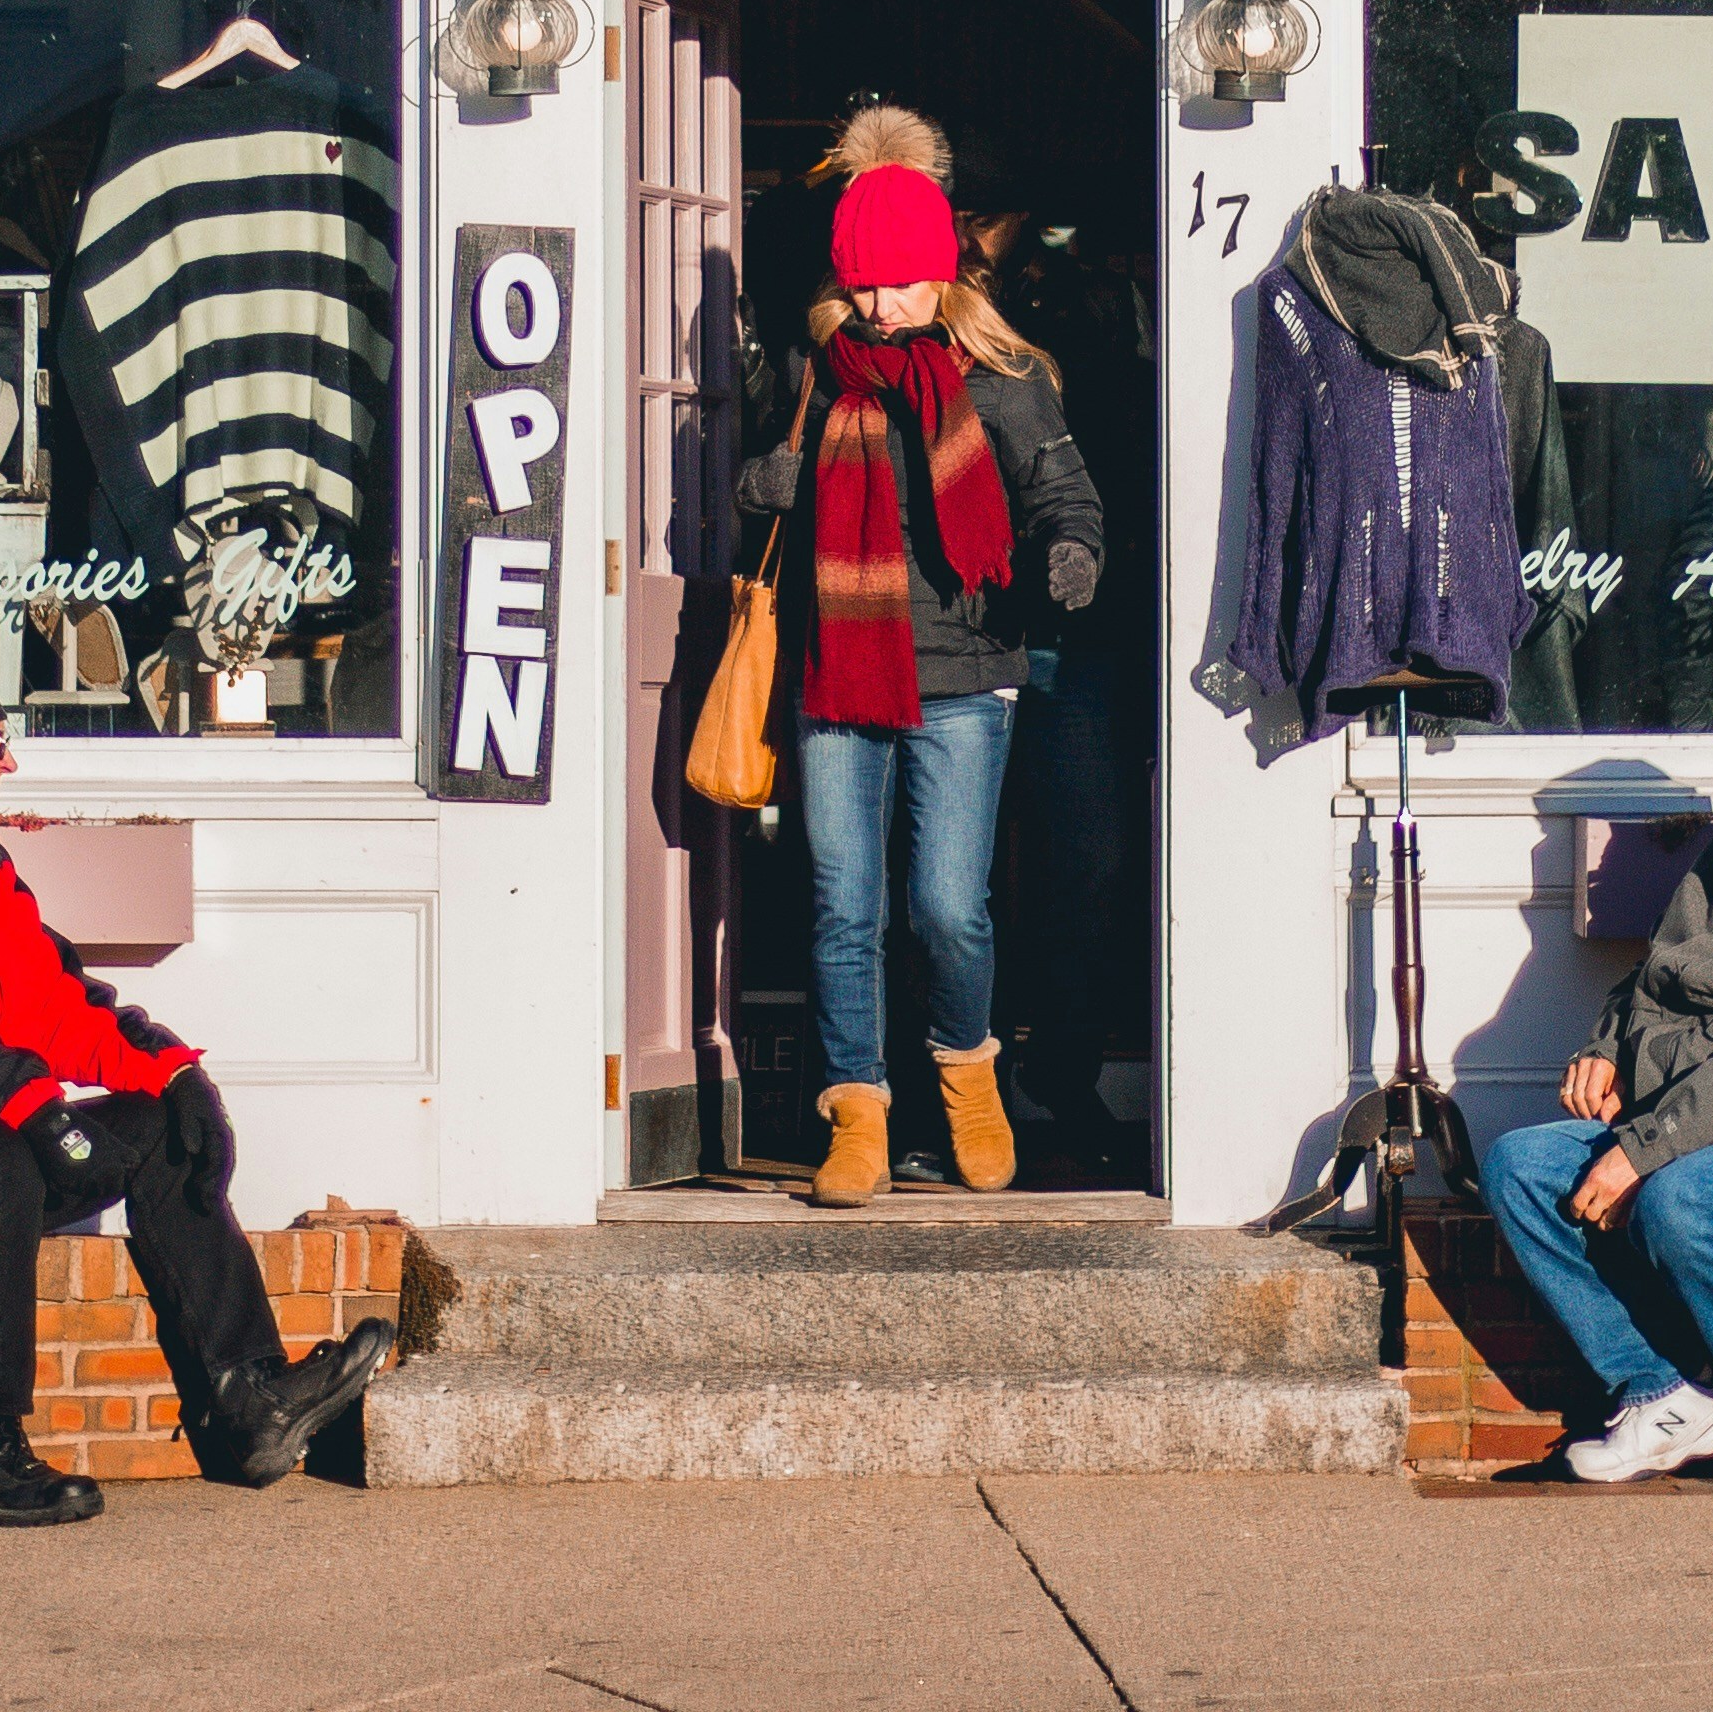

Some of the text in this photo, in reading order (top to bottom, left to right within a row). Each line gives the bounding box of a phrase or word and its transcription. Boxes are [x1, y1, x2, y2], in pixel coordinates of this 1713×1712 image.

[1188, 170, 1250, 260] 17
[451, 251, 561, 778] OPEN
[211, 527, 357, 623] Gifts
[1519, 526, 1624, 614] elry
